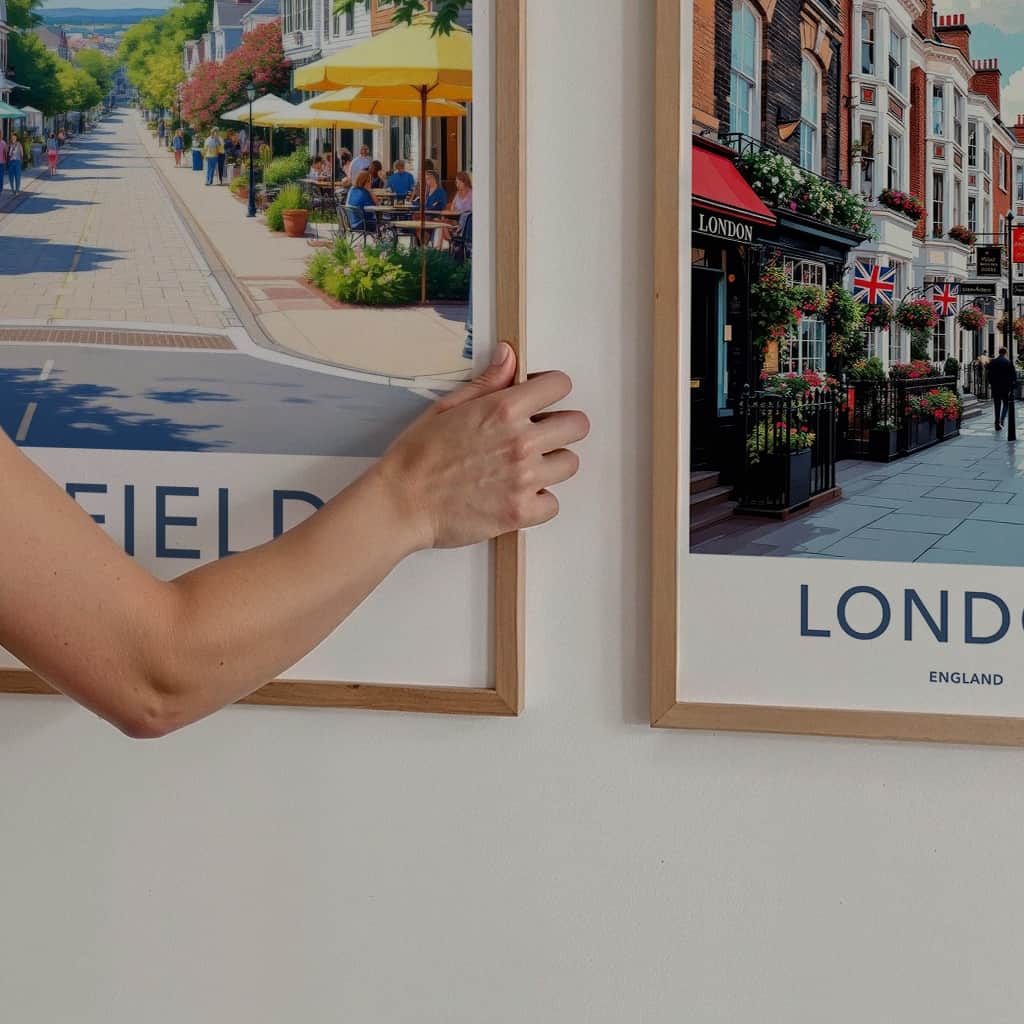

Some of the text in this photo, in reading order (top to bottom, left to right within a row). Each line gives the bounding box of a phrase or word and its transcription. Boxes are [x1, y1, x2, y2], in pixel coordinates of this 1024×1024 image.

[698, 213, 753, 242] LONDON
[800, 583, 1024, 645] LOND
[929, 671, 1004, 686] ENGLAND
